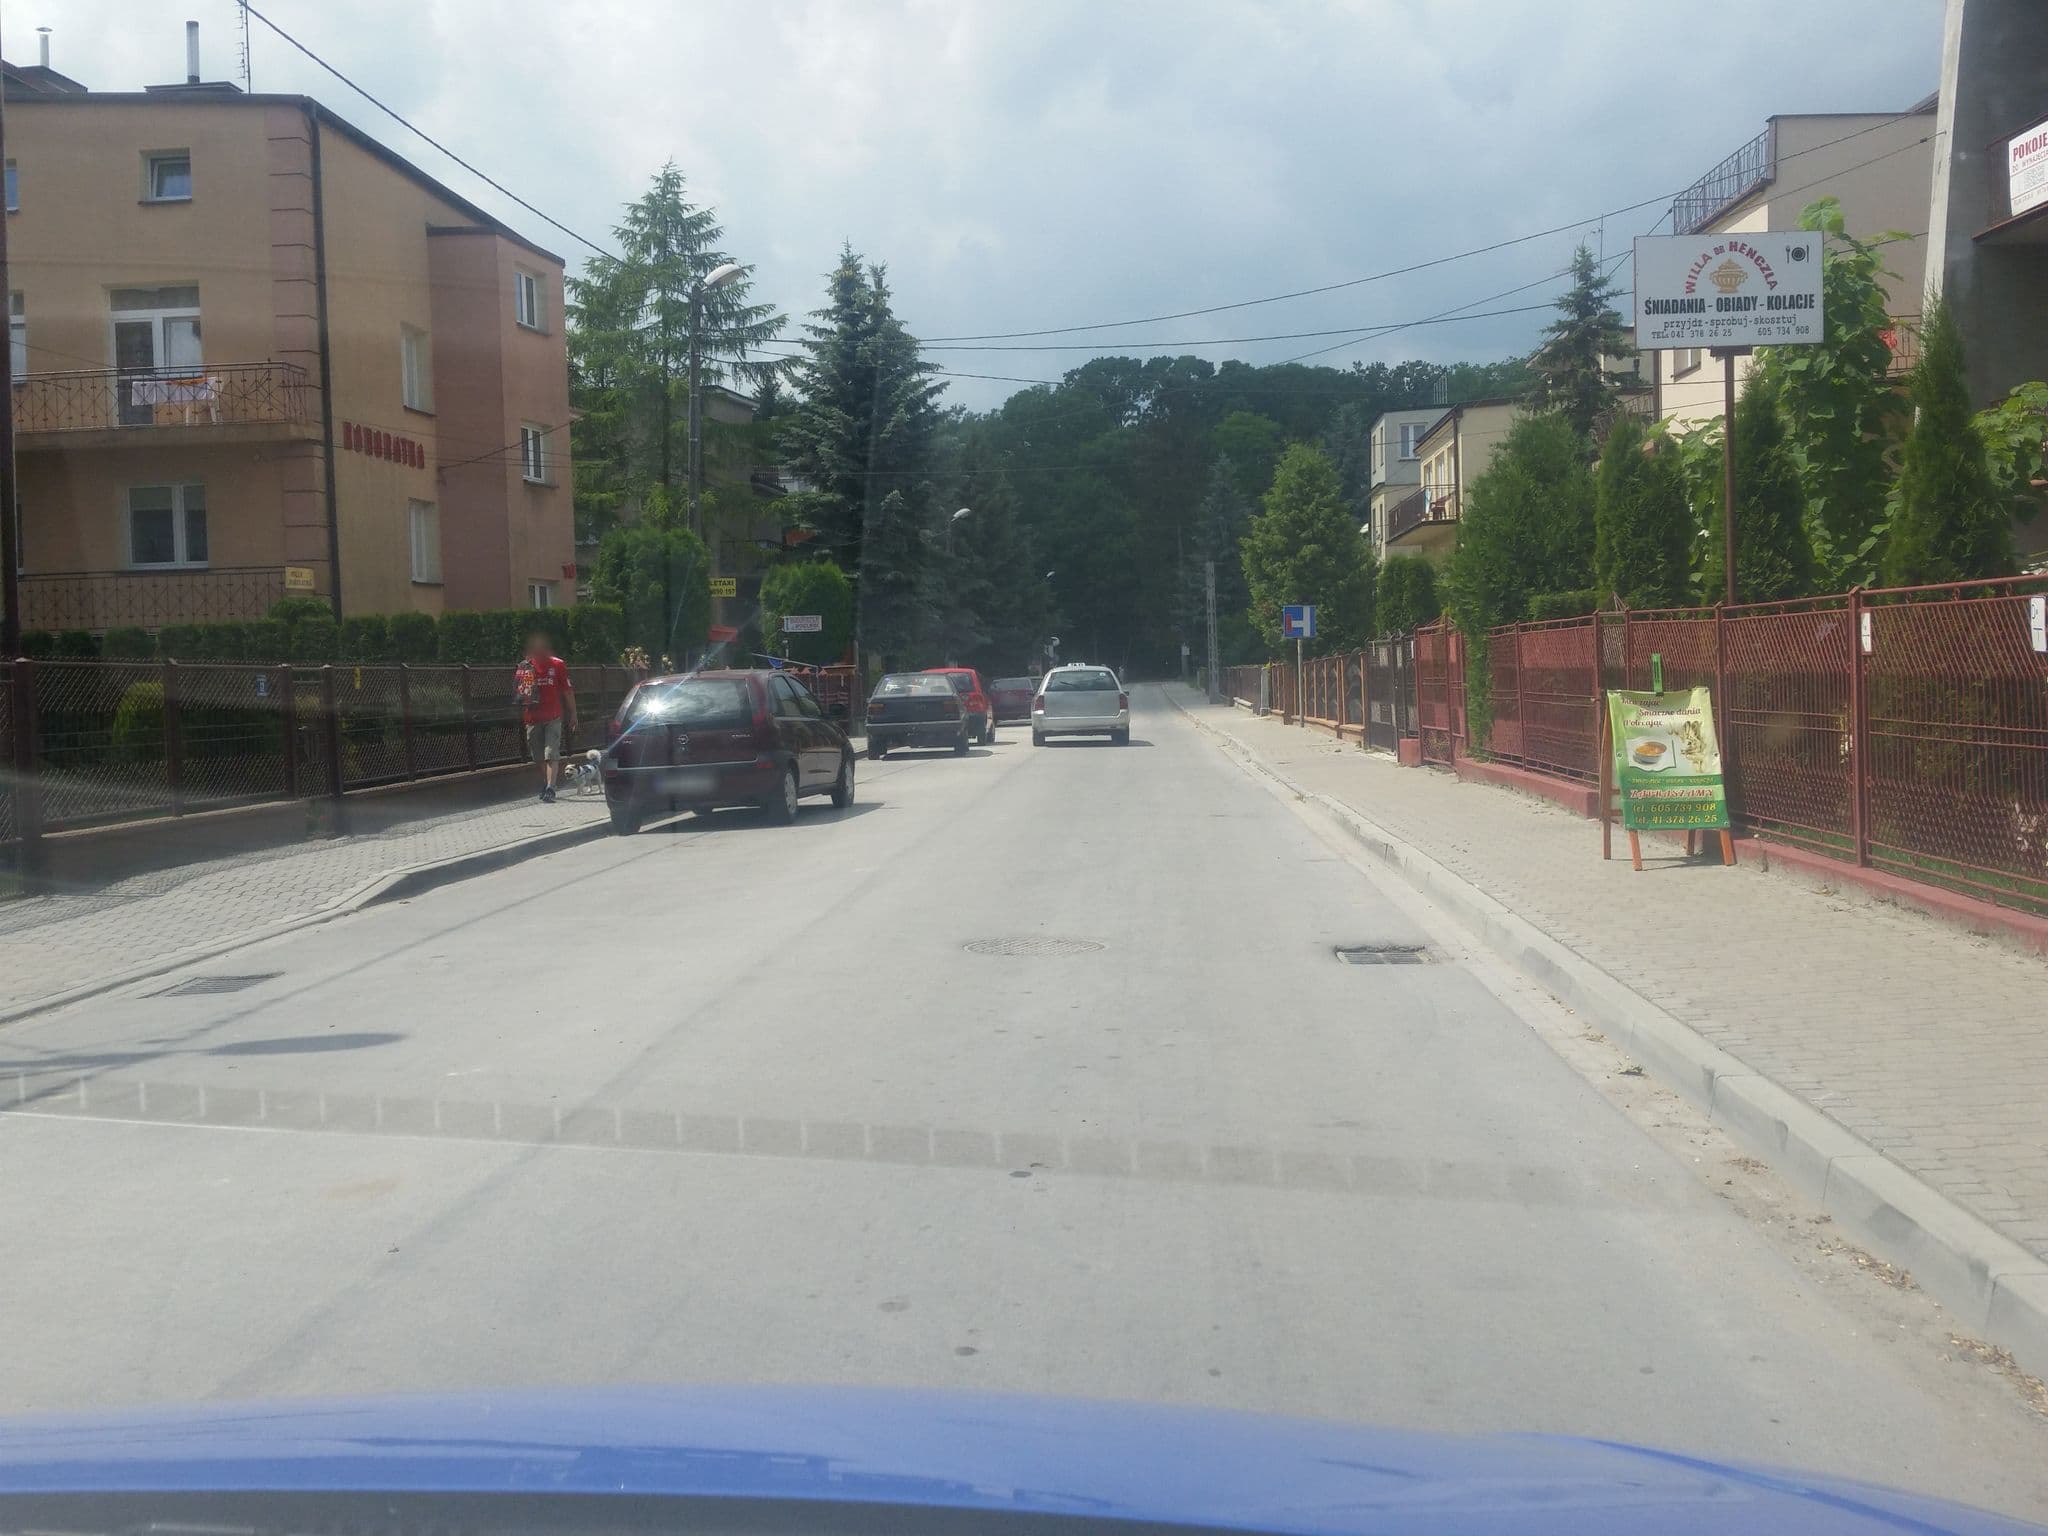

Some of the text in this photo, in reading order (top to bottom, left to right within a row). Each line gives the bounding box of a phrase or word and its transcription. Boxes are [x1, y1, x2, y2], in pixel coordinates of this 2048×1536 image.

[2013, 132, 2048, 162] POKOJE
[1685, 253, 1713, 295] WILLA
[1729, 241, 1778, 291] HENCZLA
[1645, 297, 1706, 316] ŚNIADANIA
[1716, 296, 1758, 313] OBIADY
[1767, 294, 1815, 311] KOLACJE
[1670, 330, 1685, 338] 041
[1690, 329, 1704, 338] 378
[1709, 329, 1719, 337] 26
[1722, 328, 1733, 337] 25
[1757, 328, 1772, 336] 605
[1777, 327, 1791, 335] 734
[1795, 326, 1810, 335] 908
[1676, 708, 1701, 716] dania
[1650, 804, 1671, 812] 605
[1695, 803, 1716, 812] 908
[1652, 816, 1662, 824] 41
[1666, 816, 1684, 824] 378
[1688, 815, 1700, 823] 26
[1704, 815, 1717, 823] 25
